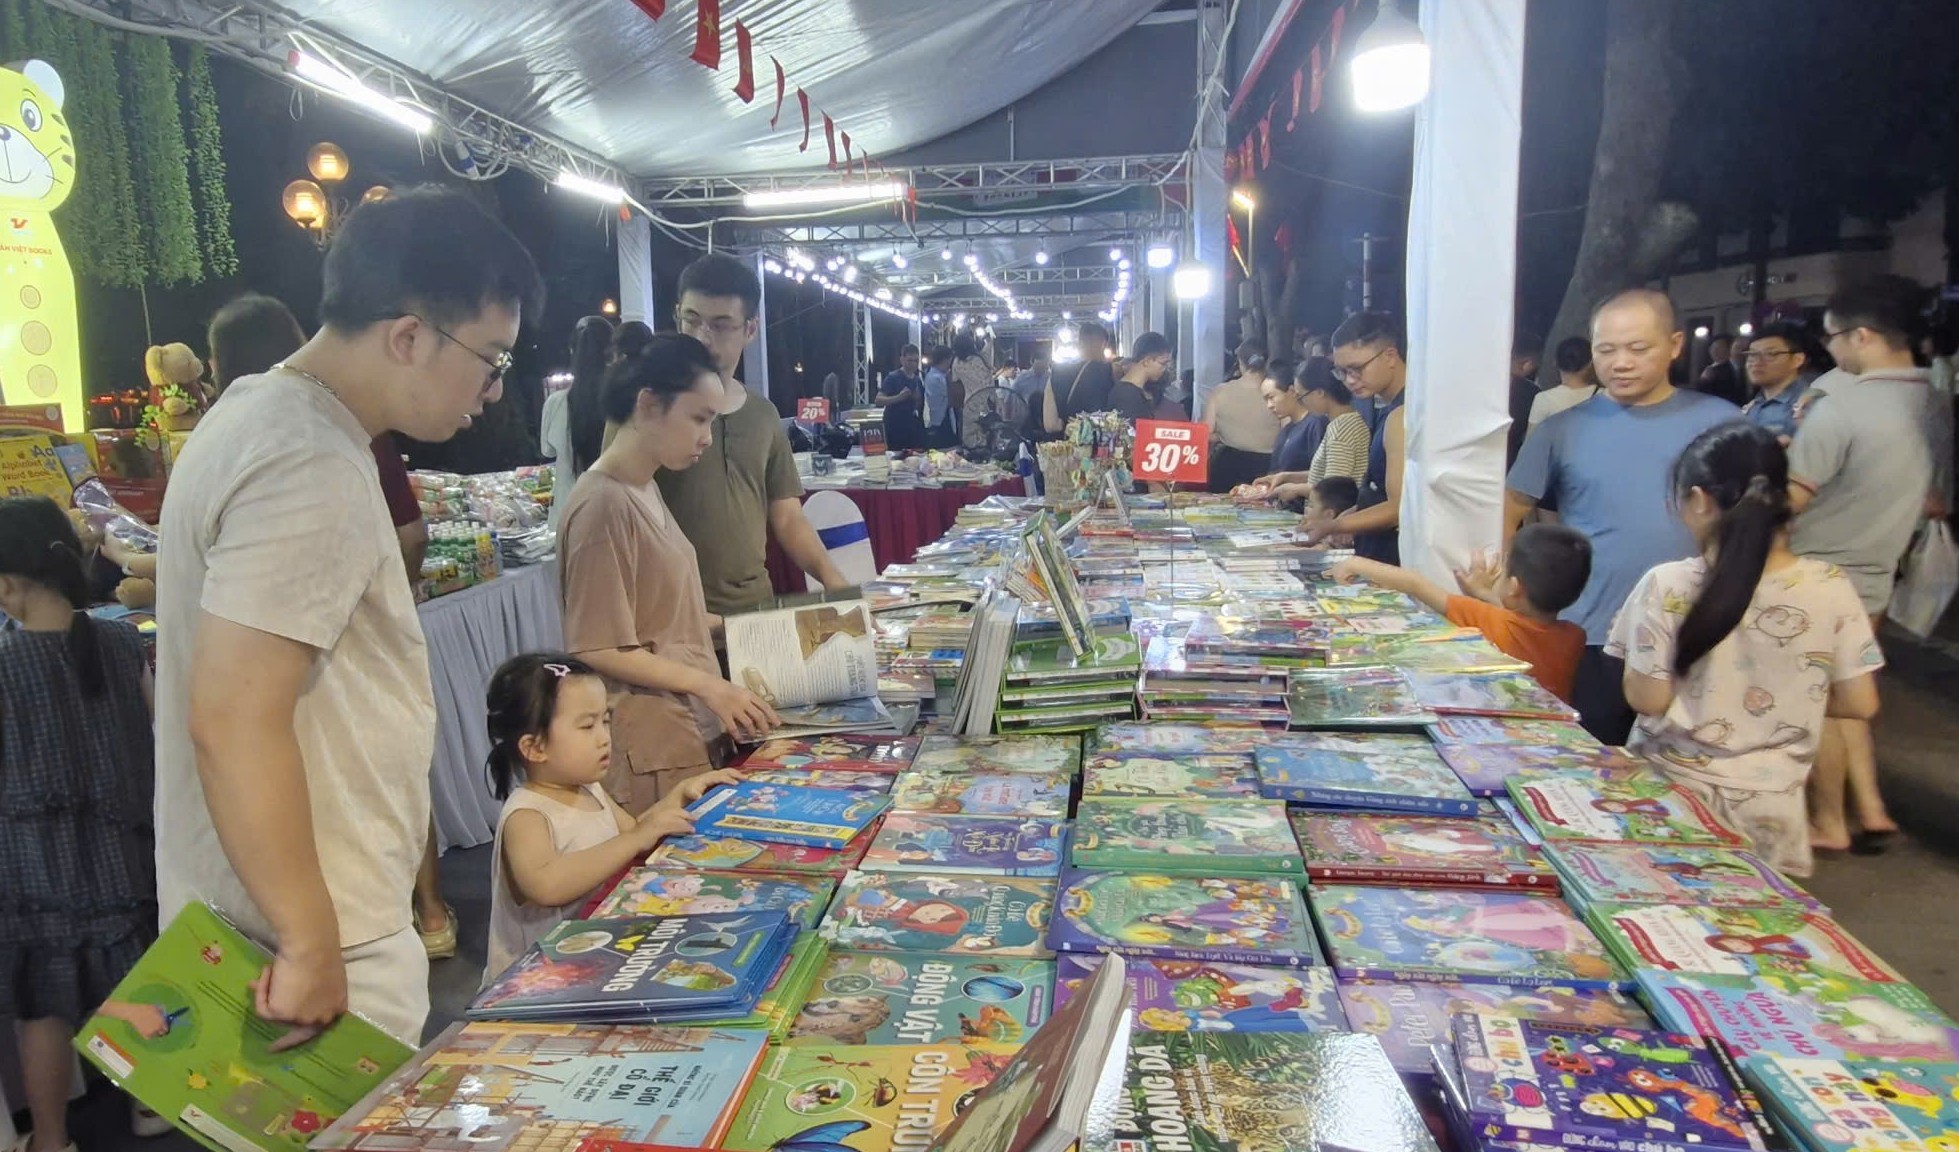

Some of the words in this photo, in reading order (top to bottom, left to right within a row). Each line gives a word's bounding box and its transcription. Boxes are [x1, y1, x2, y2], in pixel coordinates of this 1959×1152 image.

[28, 247, 52, 255] BOOKS
[801, 407, 826, 420] 20%
[1161, 430, 1185, 438] SALE
[1141, 442, 1199, 473] 30%
[651, 918, 689, 943] MÔI
[602, 943, 663, 992] TRƯỜNG
[910, 963, 954, 1005] ĐỘNG
[1745, 992, 1793, 1025] NGỰA
[893, 1009, 944, 1044] VẬT
[1400, 1014, 1437, 1047] Peter
[626, 1068, 650, 1080] CỔ
[651, 1065, 679, 1083] THẾ
[905, 1050, 955, 1094] CÔN
[609, 1083, 636, 1100] ĐẠI
[633, 1086, 662, 1106] GIỚI
[1140, 1075, 1193, 1151] HOANG
